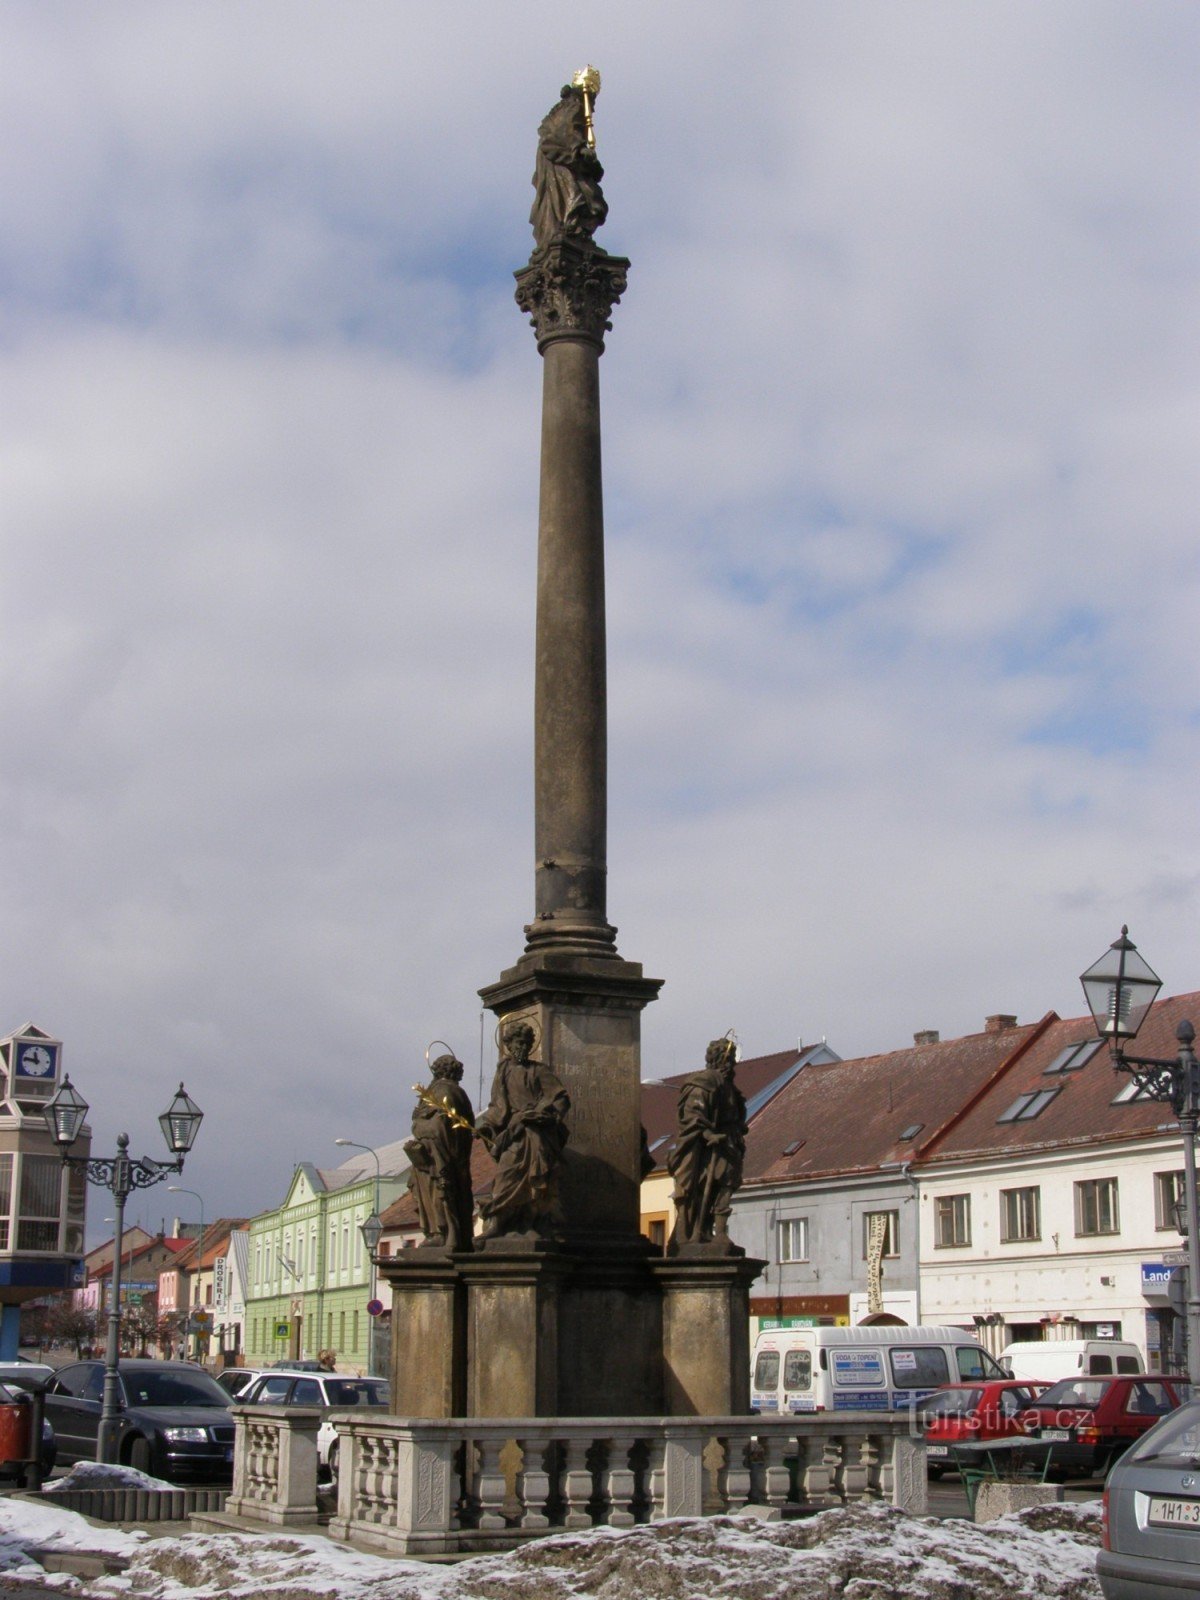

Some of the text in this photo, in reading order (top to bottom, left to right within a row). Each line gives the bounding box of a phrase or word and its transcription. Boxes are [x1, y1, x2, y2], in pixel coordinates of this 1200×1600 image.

[216, 1258, 224, 1306] DROGERIE
[1142, 1270, 1171, 1282] Land
[1161, 1502, 1182, 1521] 1H1
